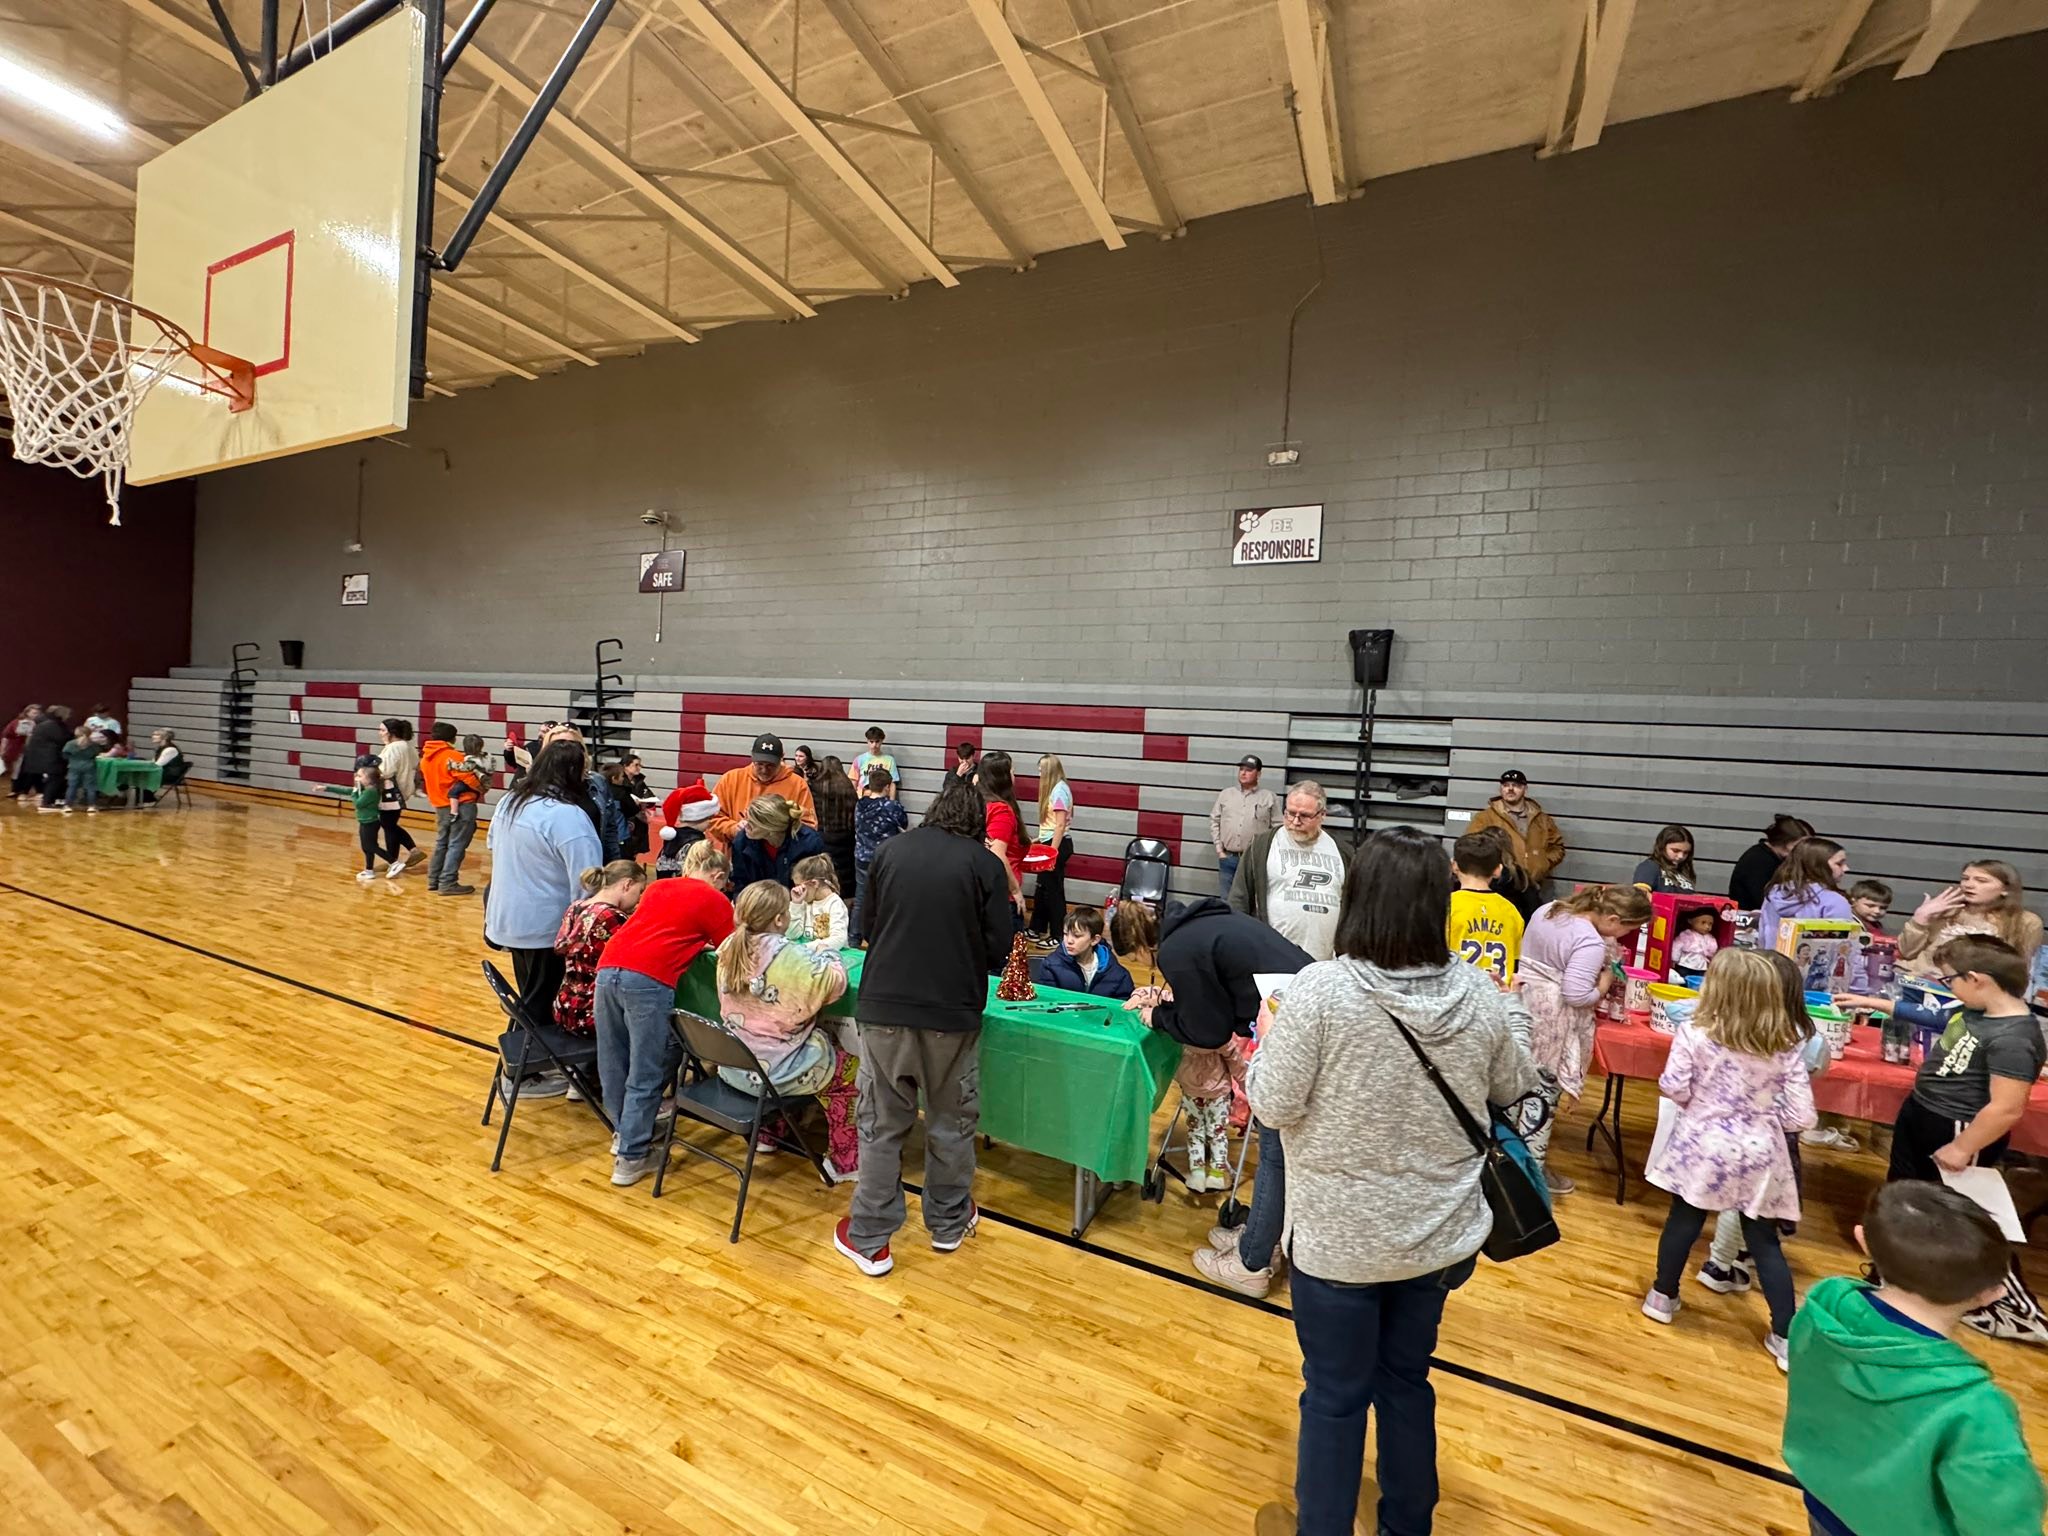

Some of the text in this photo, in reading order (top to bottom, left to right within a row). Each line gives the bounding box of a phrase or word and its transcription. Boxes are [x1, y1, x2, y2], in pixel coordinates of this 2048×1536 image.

[1271, 518, 1293, 533] BE
[1241, 538, 1315, 561] RESPONSIBLE
[652, 572, 673, 587] SAFE
[1293, 869, 1332, 890] P
[1467, 917, 1504, 936] JAMES
[1461, 940, 1506, 980] 23
